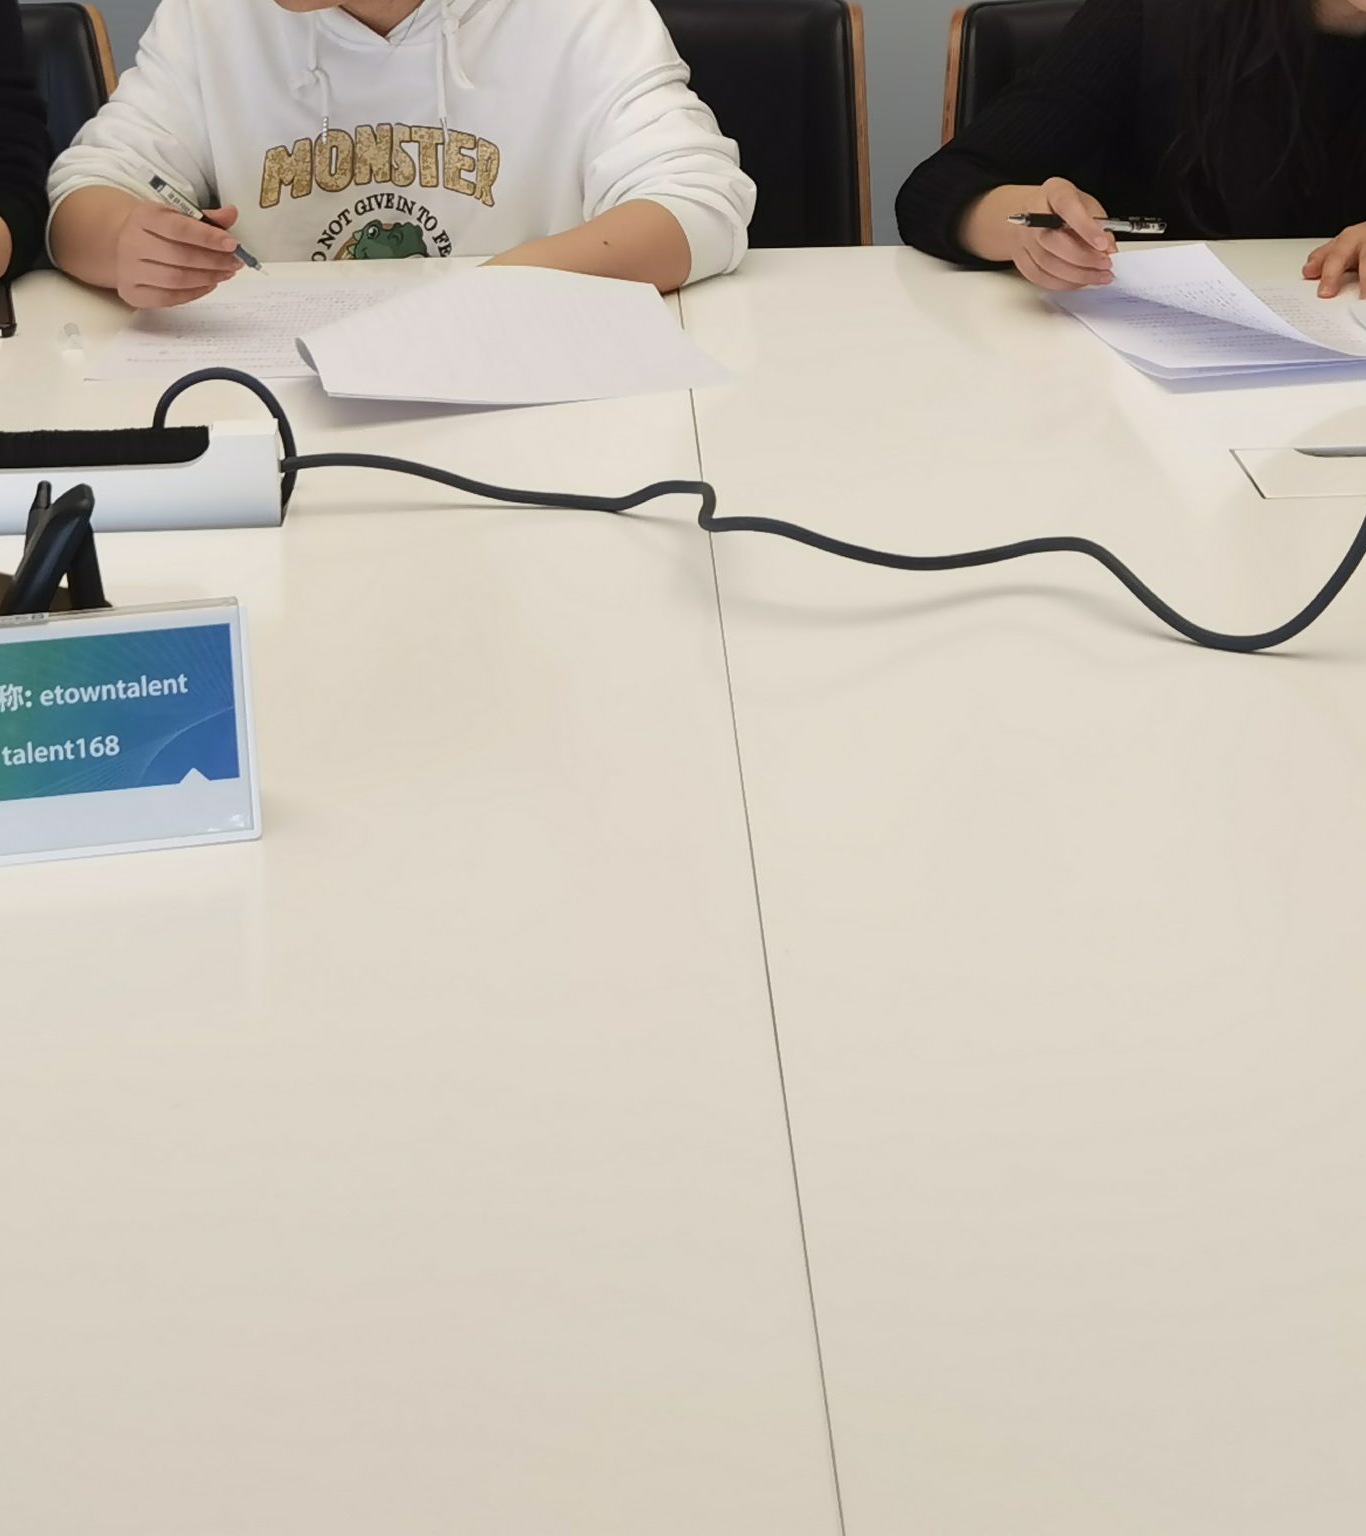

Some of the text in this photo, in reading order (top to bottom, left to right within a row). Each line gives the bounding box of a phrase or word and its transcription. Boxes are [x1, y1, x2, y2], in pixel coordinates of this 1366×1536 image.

[259, 123, 500, 208] MONSTER
[317, 208, 353, 251] NOT
[354, 193, 395, 216] GIVE
[396, 195, 416, 215] IN
[416, 206, 438, 232] TO
[432, 230, 453, 258] FE
[40, 674, 188, 707] etowntalent
[2, 735, 120, 766] talent168
